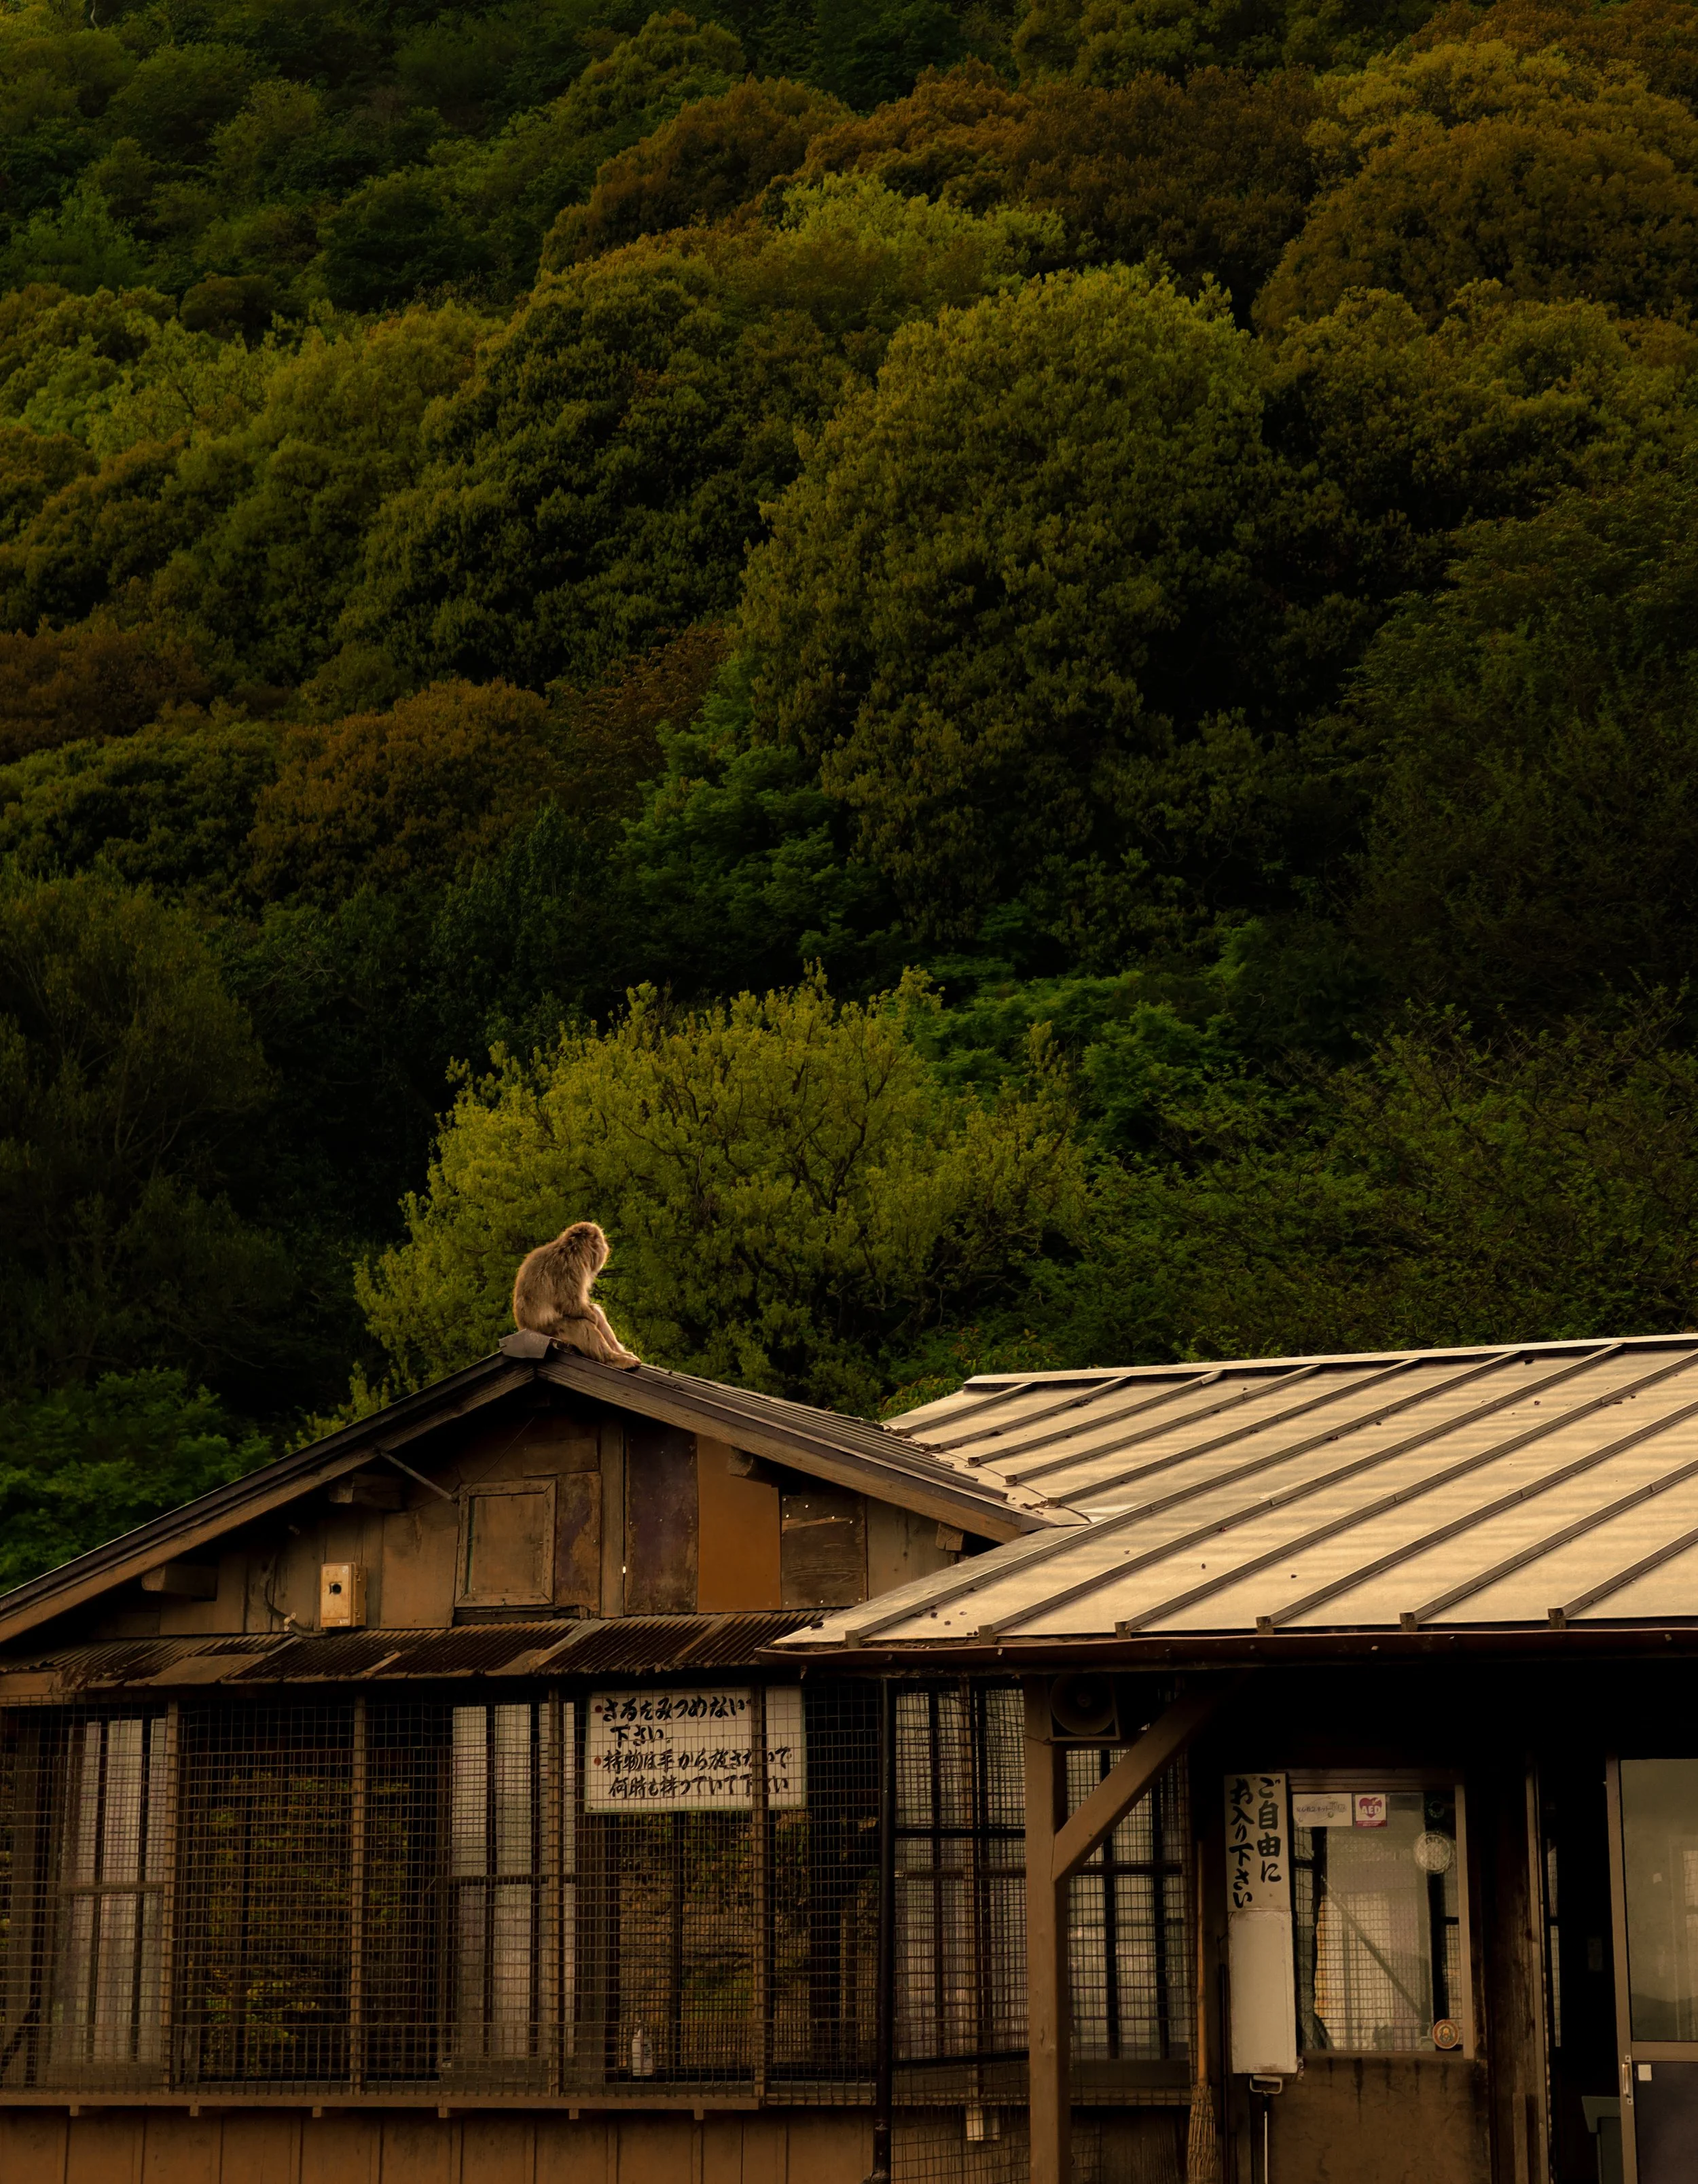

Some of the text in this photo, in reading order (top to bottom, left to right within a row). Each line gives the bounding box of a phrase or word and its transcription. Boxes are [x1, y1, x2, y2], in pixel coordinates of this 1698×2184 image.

[1229, 1779, 1254, 1909] お入り下さい
[1257, 1777, 1281, 1883] ご自由に
[1361, 1806, 1381, 1814] AED
